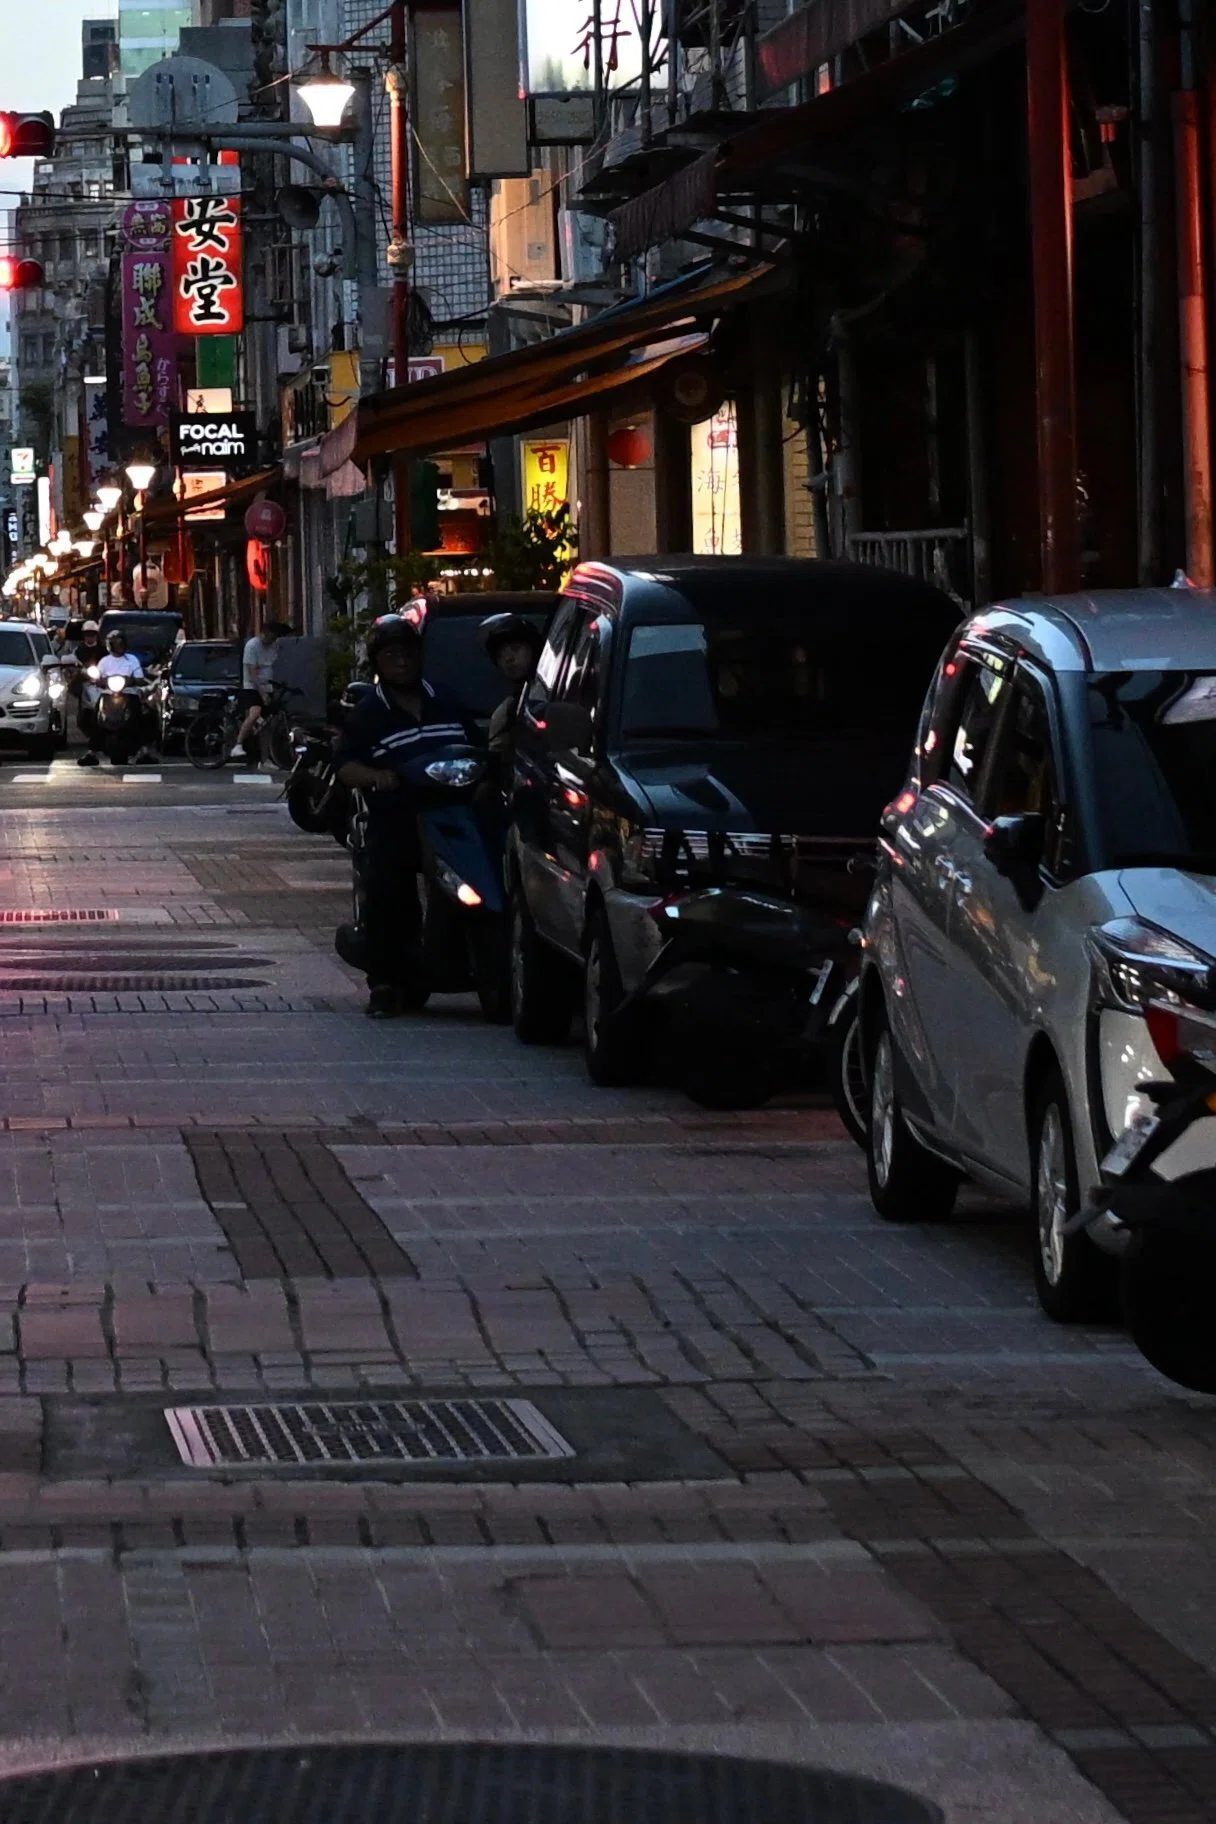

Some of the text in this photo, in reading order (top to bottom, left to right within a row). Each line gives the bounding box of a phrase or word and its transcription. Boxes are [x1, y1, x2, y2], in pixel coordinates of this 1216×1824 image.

[177, 150, 237, 324] 安堂
[179, 423, 245, 441] FOCAL
[201, 438, 245, 456] naim
